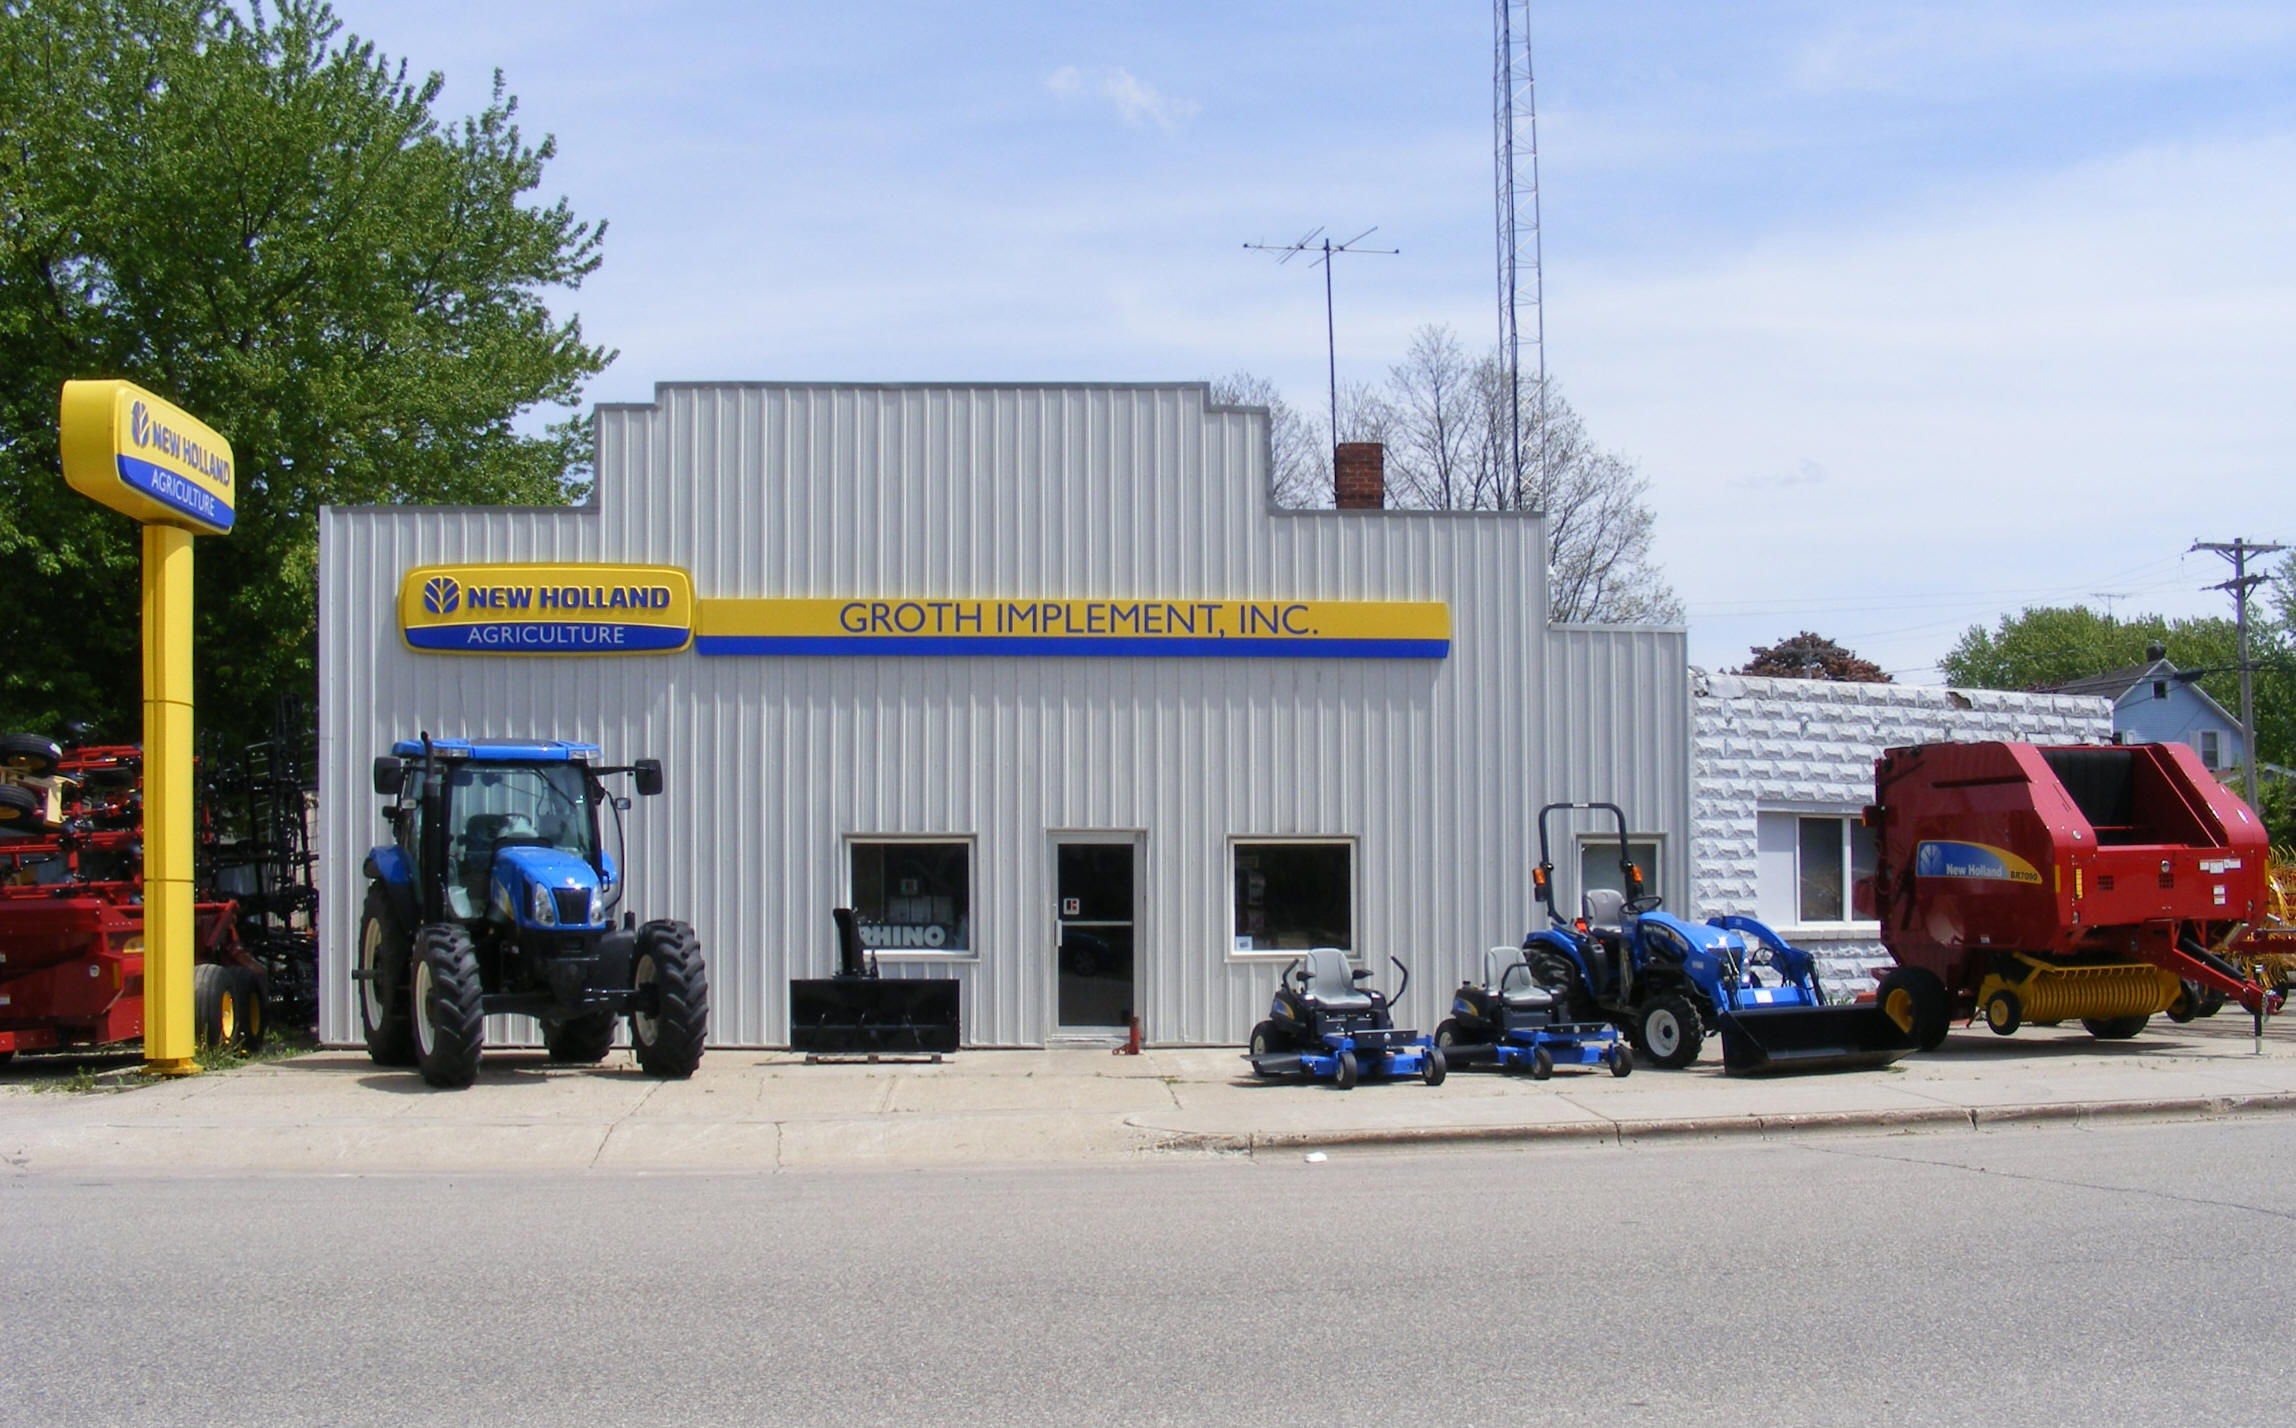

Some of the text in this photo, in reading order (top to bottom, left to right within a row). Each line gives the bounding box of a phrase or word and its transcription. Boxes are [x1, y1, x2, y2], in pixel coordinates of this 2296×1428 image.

[152, 421, 231, 487] NEW HOLLAND
[151, 469, 215, 517] AGRICULTURE
[467, 586, 671, 609] NEW HOLLAND
[840, 602, 1319, 638] GROTH IMPLEMENT, INC.
[467, 626, 625, 644] AGRICULTURE
[1945, 863, 2002, 877] New Holland
[858, 924, 946, 947] RHINO
